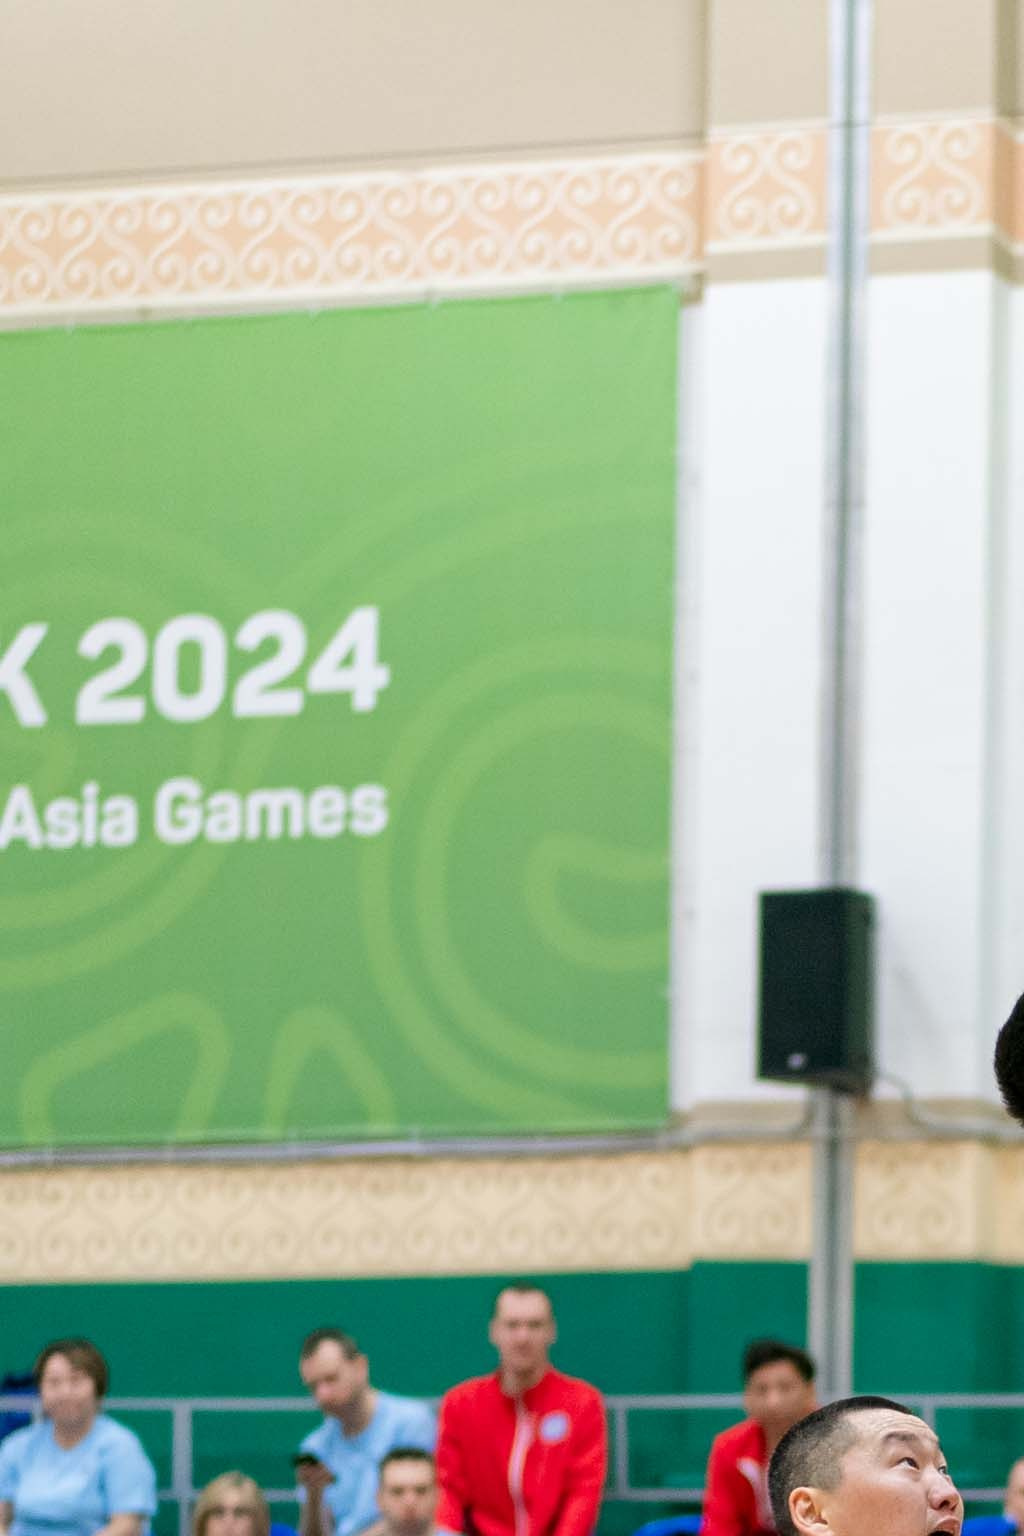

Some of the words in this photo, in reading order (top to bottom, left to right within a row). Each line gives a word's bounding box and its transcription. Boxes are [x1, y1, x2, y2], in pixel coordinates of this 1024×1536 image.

[75, 604, 391, 726] 2024
[0, 780, 139, 850] Asia
[153, 776, 390, 845] Games
